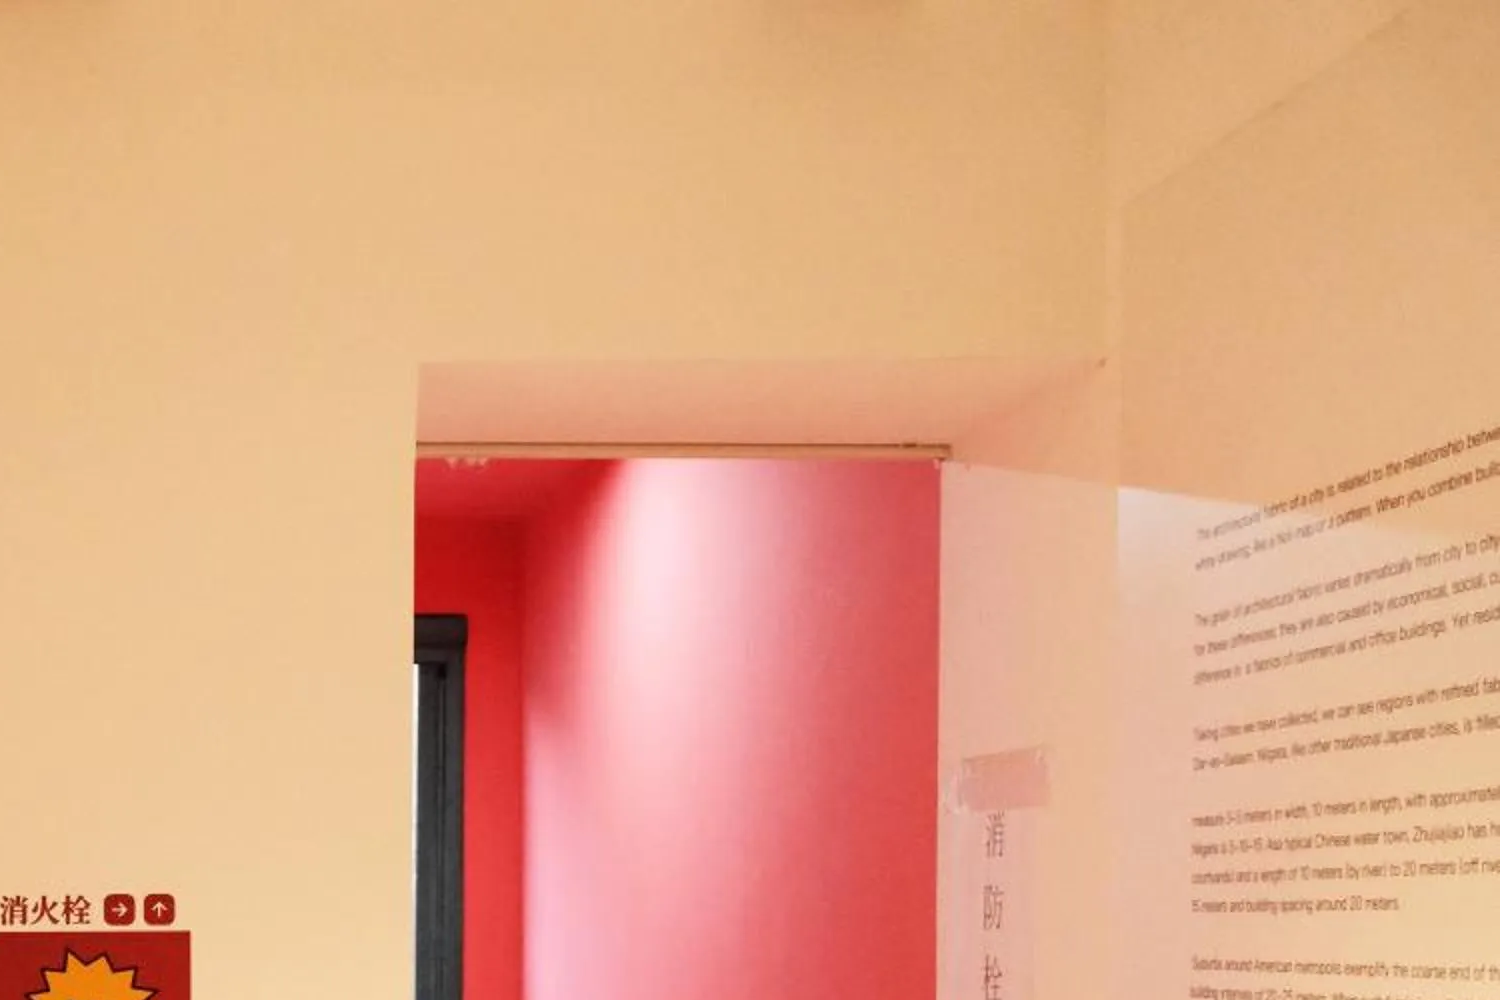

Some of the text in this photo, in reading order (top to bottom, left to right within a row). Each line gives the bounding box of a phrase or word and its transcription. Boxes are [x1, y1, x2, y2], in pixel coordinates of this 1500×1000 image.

[1375, 494, 1405, 513] When
[1406, 488, 1425, 507] you
[1427, 471, 1473, 497] combine
[1442, 544, 1462, 562] city
[1467, 823, 1487, 839] has
[0, 895, 91, 925] 消火栓
